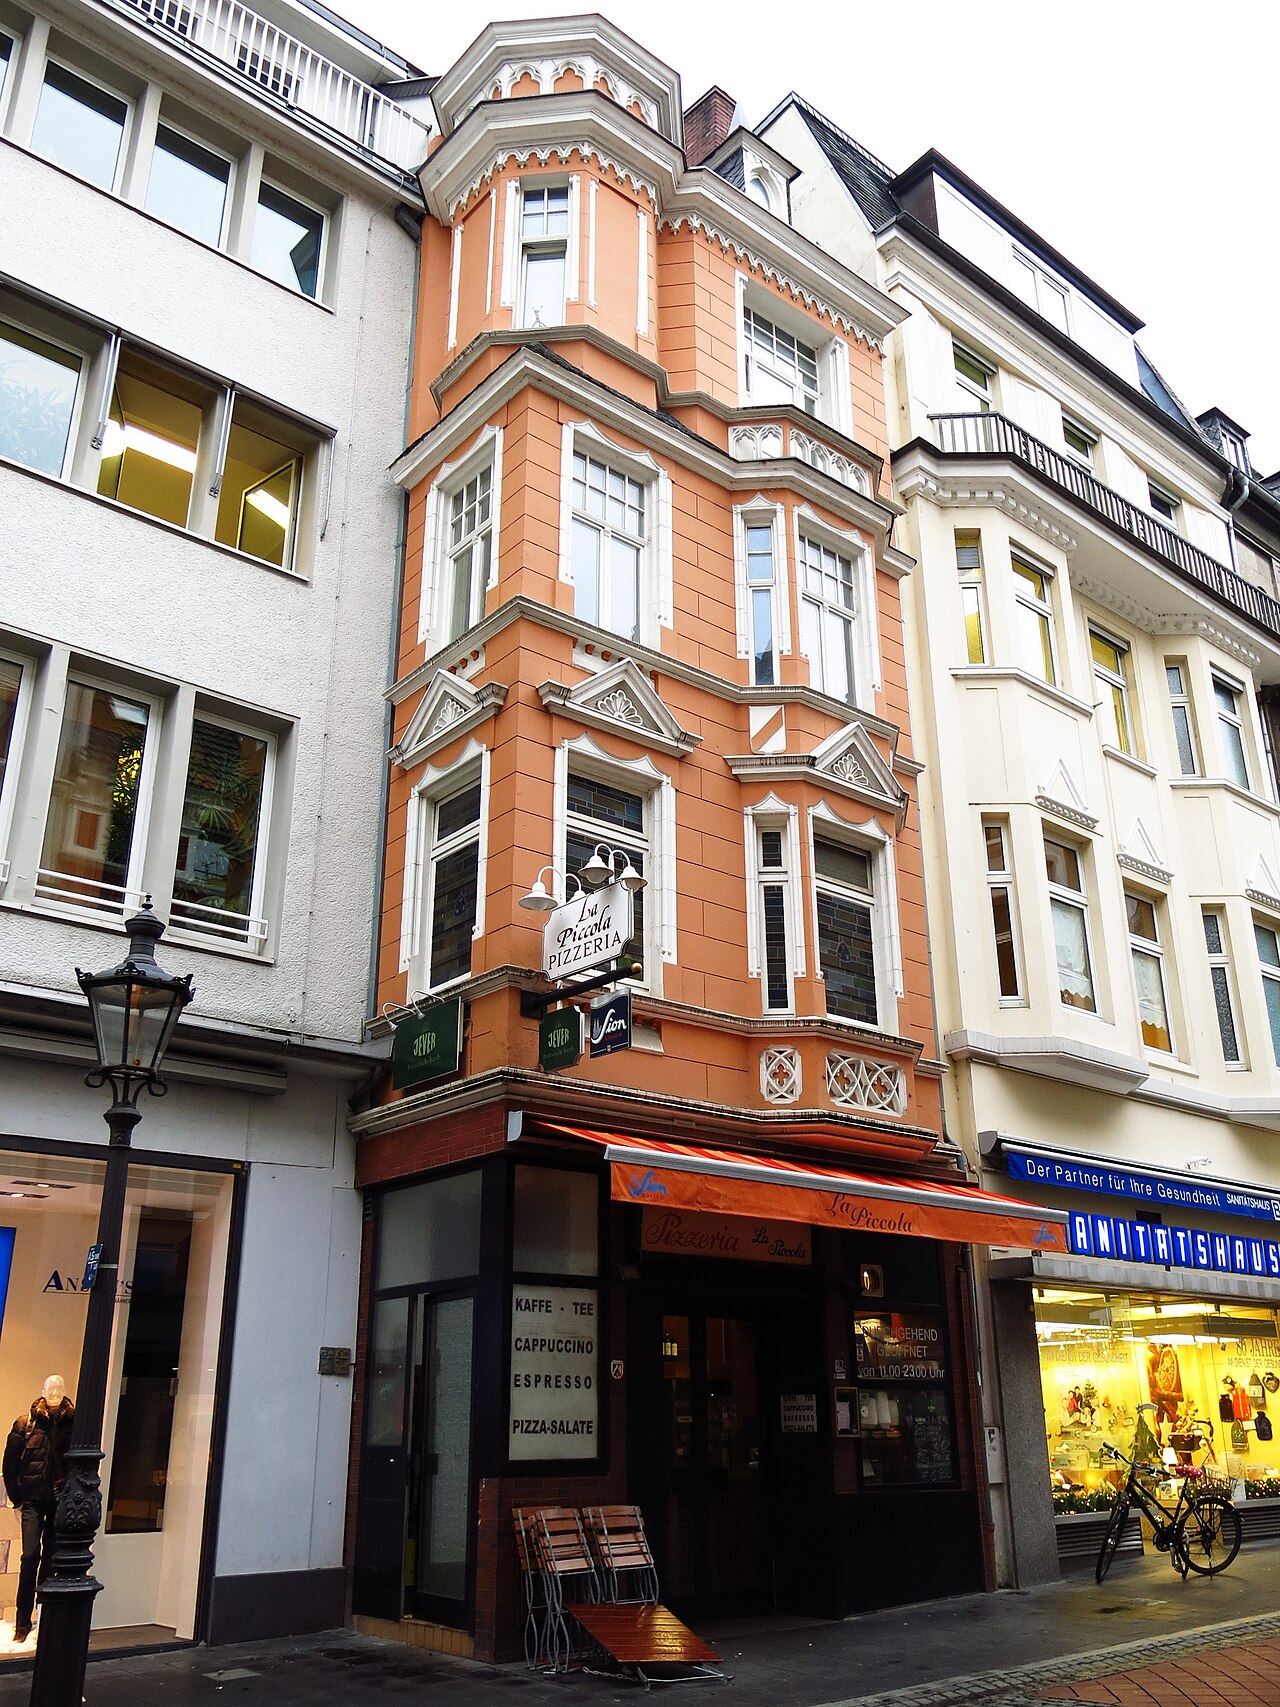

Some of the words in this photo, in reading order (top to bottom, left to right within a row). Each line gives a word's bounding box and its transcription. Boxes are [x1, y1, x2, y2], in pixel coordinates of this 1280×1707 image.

[578, 893, 599, 923] La
[557, 905, 612, 949] Piccola
[549, 930, 622, 971] PIZZERIA
[548, 1028, 570, 1048] JEVER
[591, 1008, 627, 1044] Sion
[413, 1032, 436, 1057] JEVER
[1026, 1160, 1051, 1178] Der
[1055, 1165, 1103, 1187] Partner
[1109, 1174, 1125, 1191] für
[1130, 1178, 1152, 1196] Ihre
[1157, 1183, 1220, 1207] Gesundheit
[1226, 1193, 1271, 1211] SANITÄTSHAUS
[825, 1192, 851, 1217] La
[645, 1211, 740, 1253] Pizzeria
[850, 1206, 913, 1233] Piccola
[752, 1227, 769, 1245] La
[768, 1238, 806, 1258] Piccola
[1076, 1217, 1280, 1274] ANITÄTSHAUS
[515, 1298, 552, 1313] KAFFE
[573, 1302, 594, 1316] TEE
[514, 1337, 594, 1354] CAPPUCCINO
[513, 1374, 592, 1389] ESPRESSO
[858, 1366, 875, 1377] von
[929, 1366, 945, 1378] Uhr
[512, 1419, 594, 1435] PIZZA-SALATE
